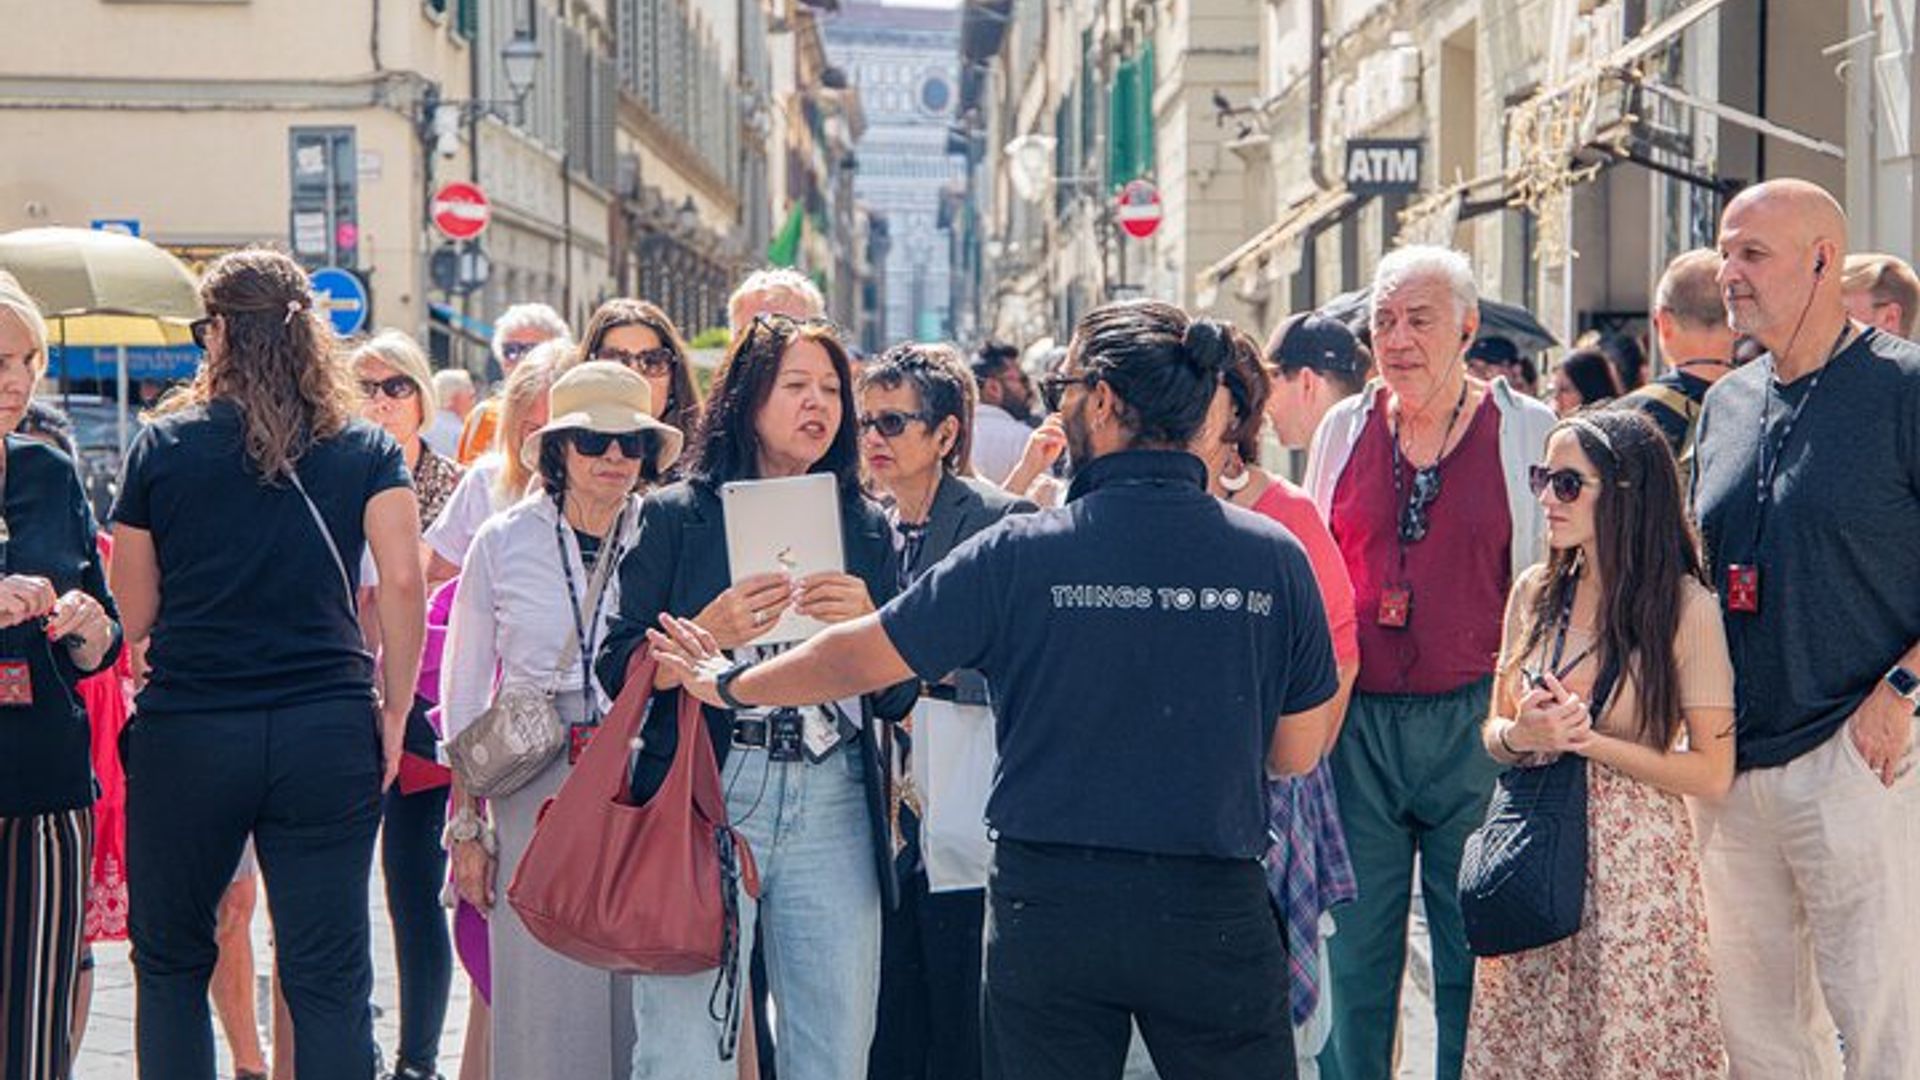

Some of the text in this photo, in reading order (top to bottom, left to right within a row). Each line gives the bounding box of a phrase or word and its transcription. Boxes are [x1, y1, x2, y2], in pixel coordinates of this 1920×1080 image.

[1348, 148, 1417, 182] ATM
[1051, 585, 1273, 616] THINGS TO DO IN
